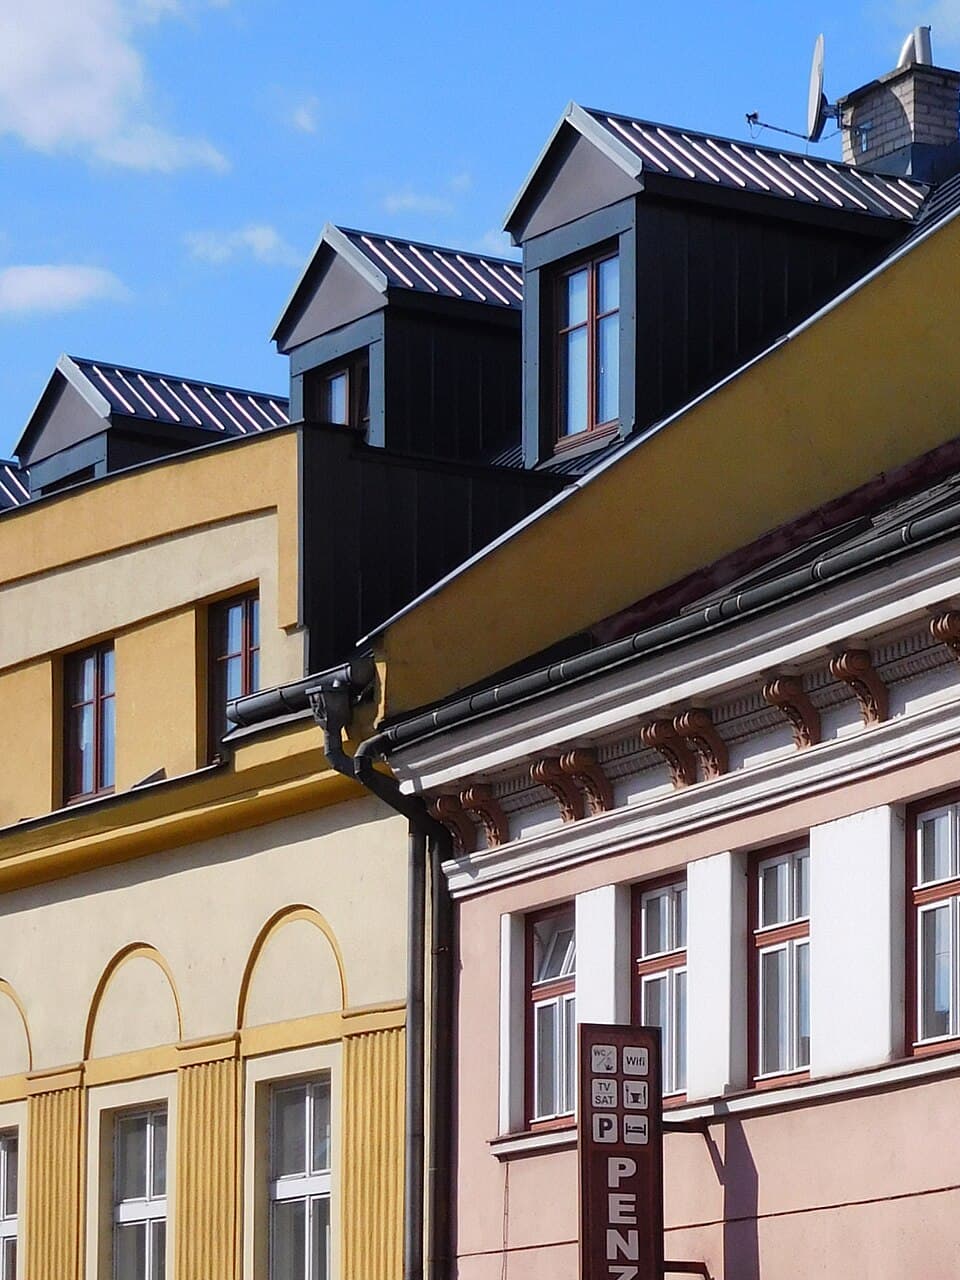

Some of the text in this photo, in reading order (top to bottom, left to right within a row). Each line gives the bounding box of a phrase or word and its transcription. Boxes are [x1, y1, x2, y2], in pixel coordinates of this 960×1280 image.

[626, 1055, 646, 1066] Wifi
[598, 1082, 611, 1091] TV
[595, 1095, 614, 1105] SAT
[599, 1118, 613, 1138] P
